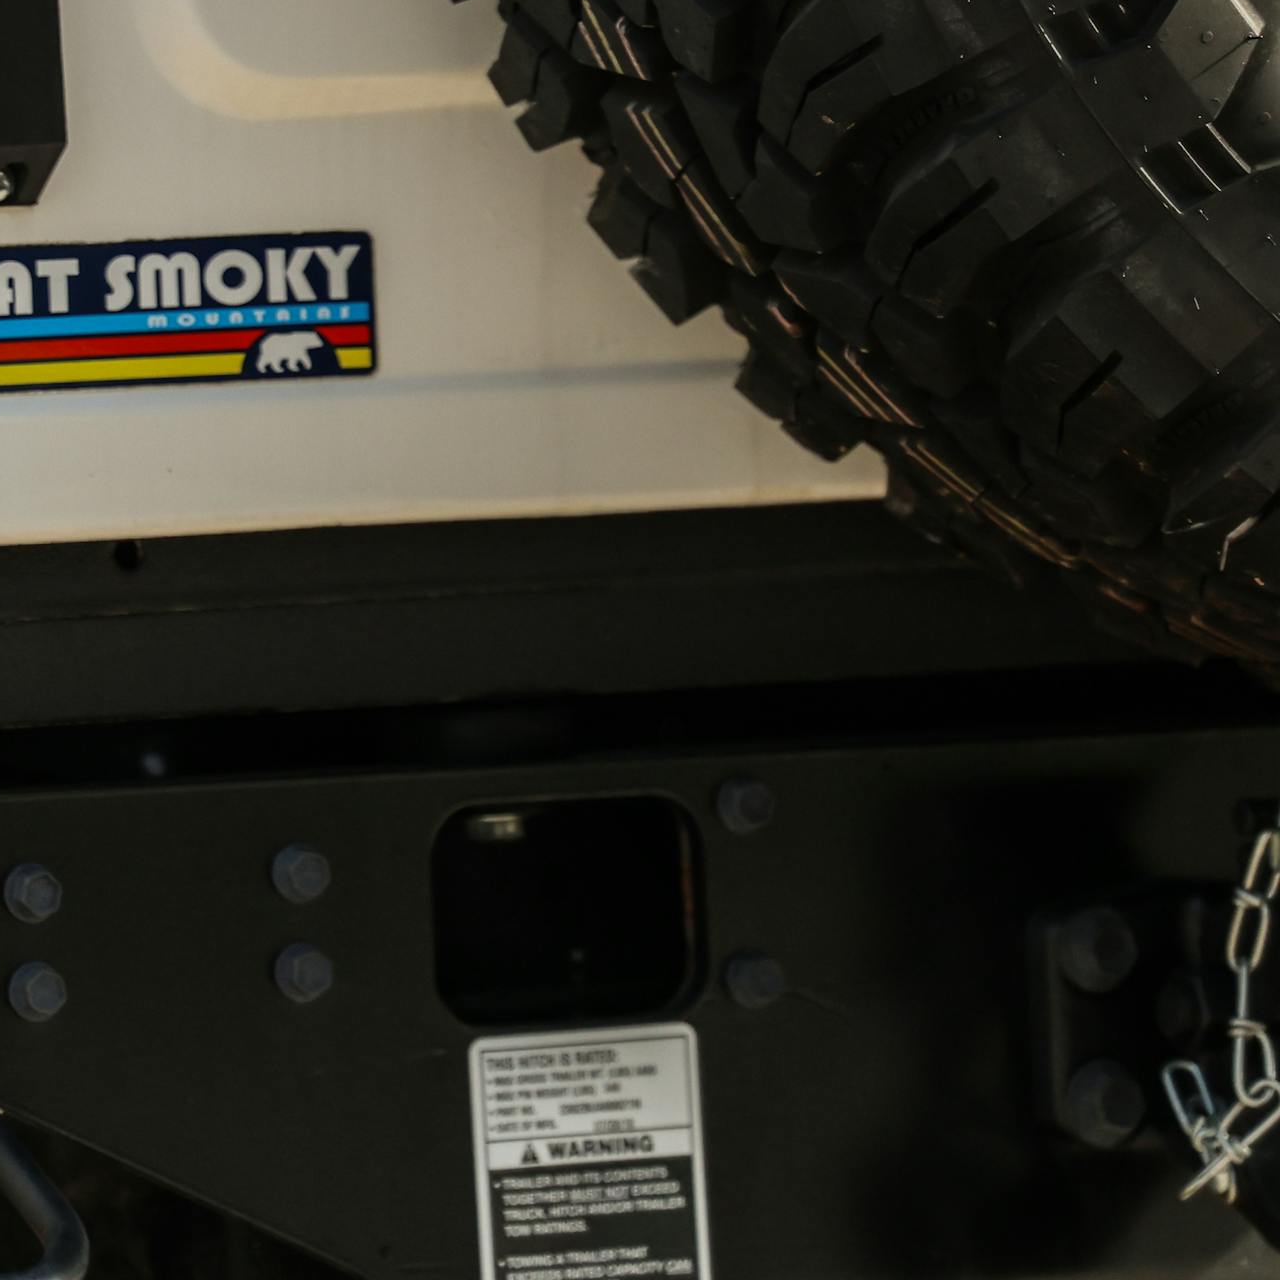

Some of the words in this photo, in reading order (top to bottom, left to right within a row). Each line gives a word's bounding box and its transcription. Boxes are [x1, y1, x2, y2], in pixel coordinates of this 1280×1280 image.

[104, 244, 362, 312] SMOKY
[147, 306, 352, 329] MOUNTAINS
[547, 1135, 654, 1159] WARNING
